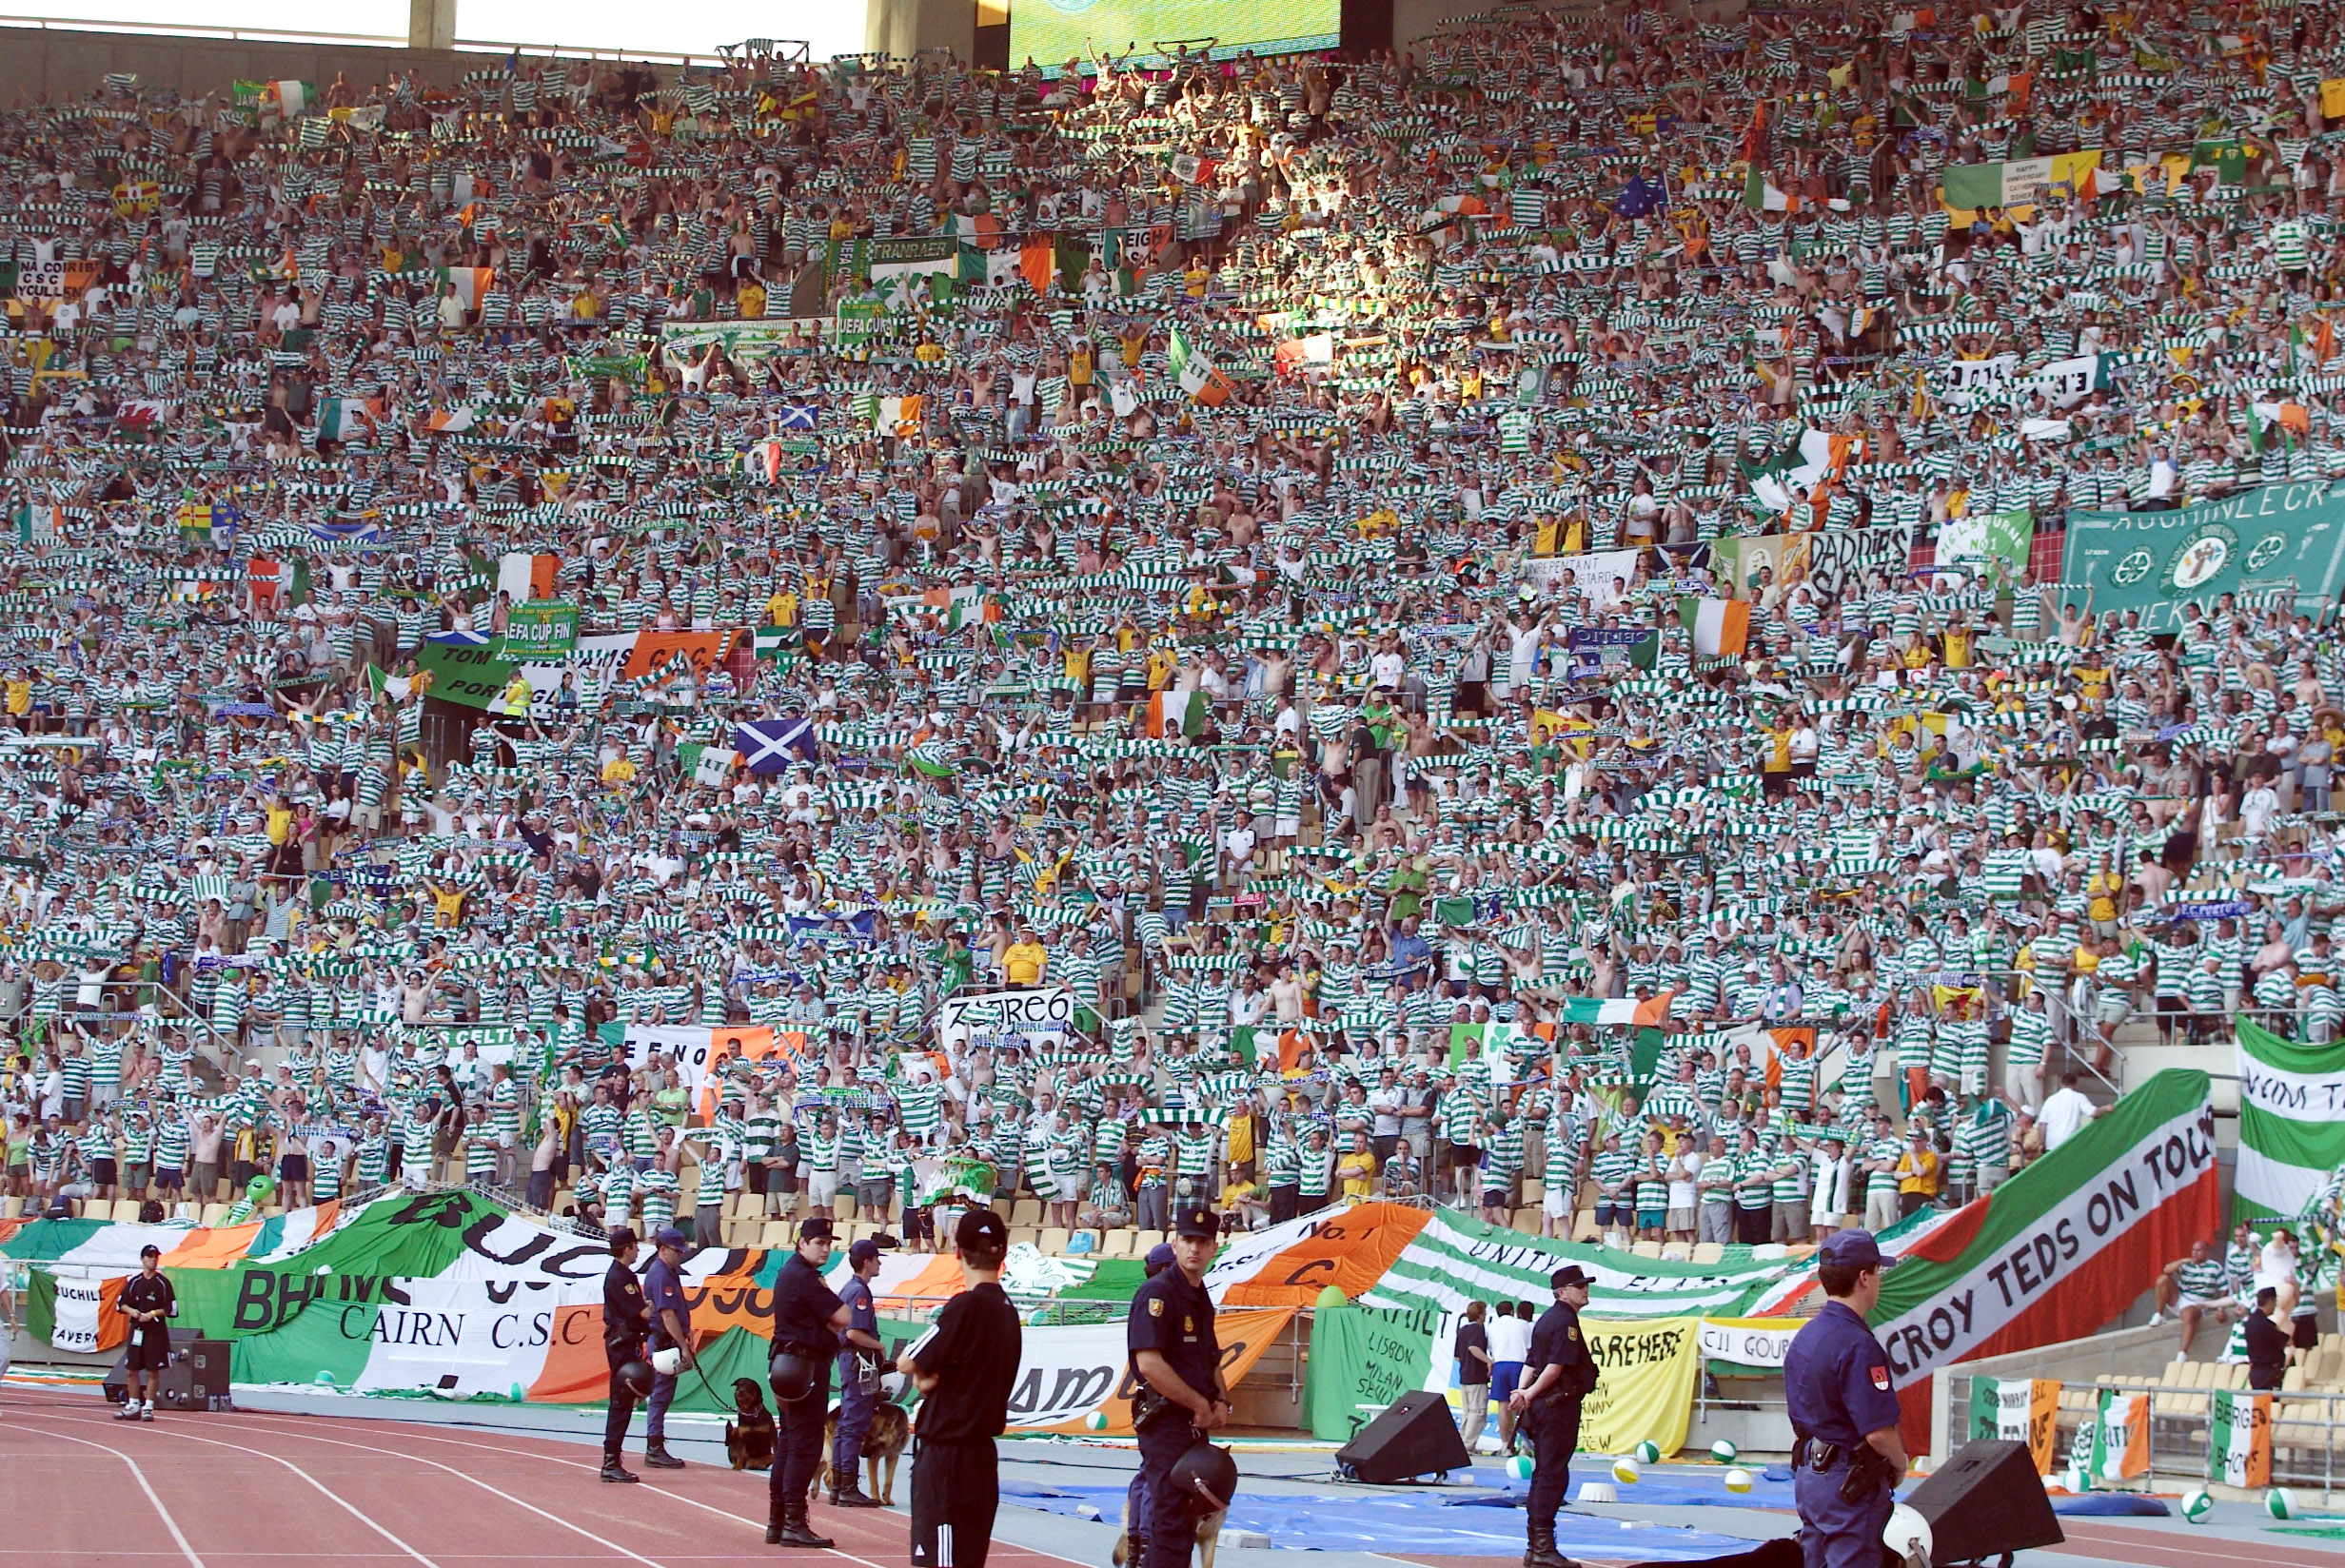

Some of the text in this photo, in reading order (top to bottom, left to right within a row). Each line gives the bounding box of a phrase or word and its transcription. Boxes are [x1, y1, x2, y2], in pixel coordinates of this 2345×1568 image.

[874, 242, 948, 260] TRANRAER
[20, 262, 38, 273] NA
[44, 262, 99, 274] COIRIB
[839, 318, 864, 334] UEFA
[1575, 569, 1619, 587] ASTARDS
[507, 621, 571, 641] EFA CUP FIN
[443, 647, 494, 665] TOM
[684, 755, 731, 775] CELTI
[314, 865, 385, 882] CELC
[309, 1019, 356, 1029] CELTIC
[1986, 1218, 2080, 1308] TEDS
[2086, 1167, 2140, 1237] ON
[1468, 1240, 1564, 1273] UNITY
[53, 1284, 106, 1302] RUCHILL
[50, 1324, 100, 1344] TAVERN
[340, 1303, 592, 1350] CAIRN C.S.C
[1369, 1331, 1415, 1366] LISBON
[1744, 1335, 1790, 1359] GOUR
[1366, 1360, 1403, 1392] MILAN
[1592, 1382, 1609, 1399] HN
[1580, 1401, 1614, 1416] ANNY
[1579, 1419, 1594, 1433] AT
